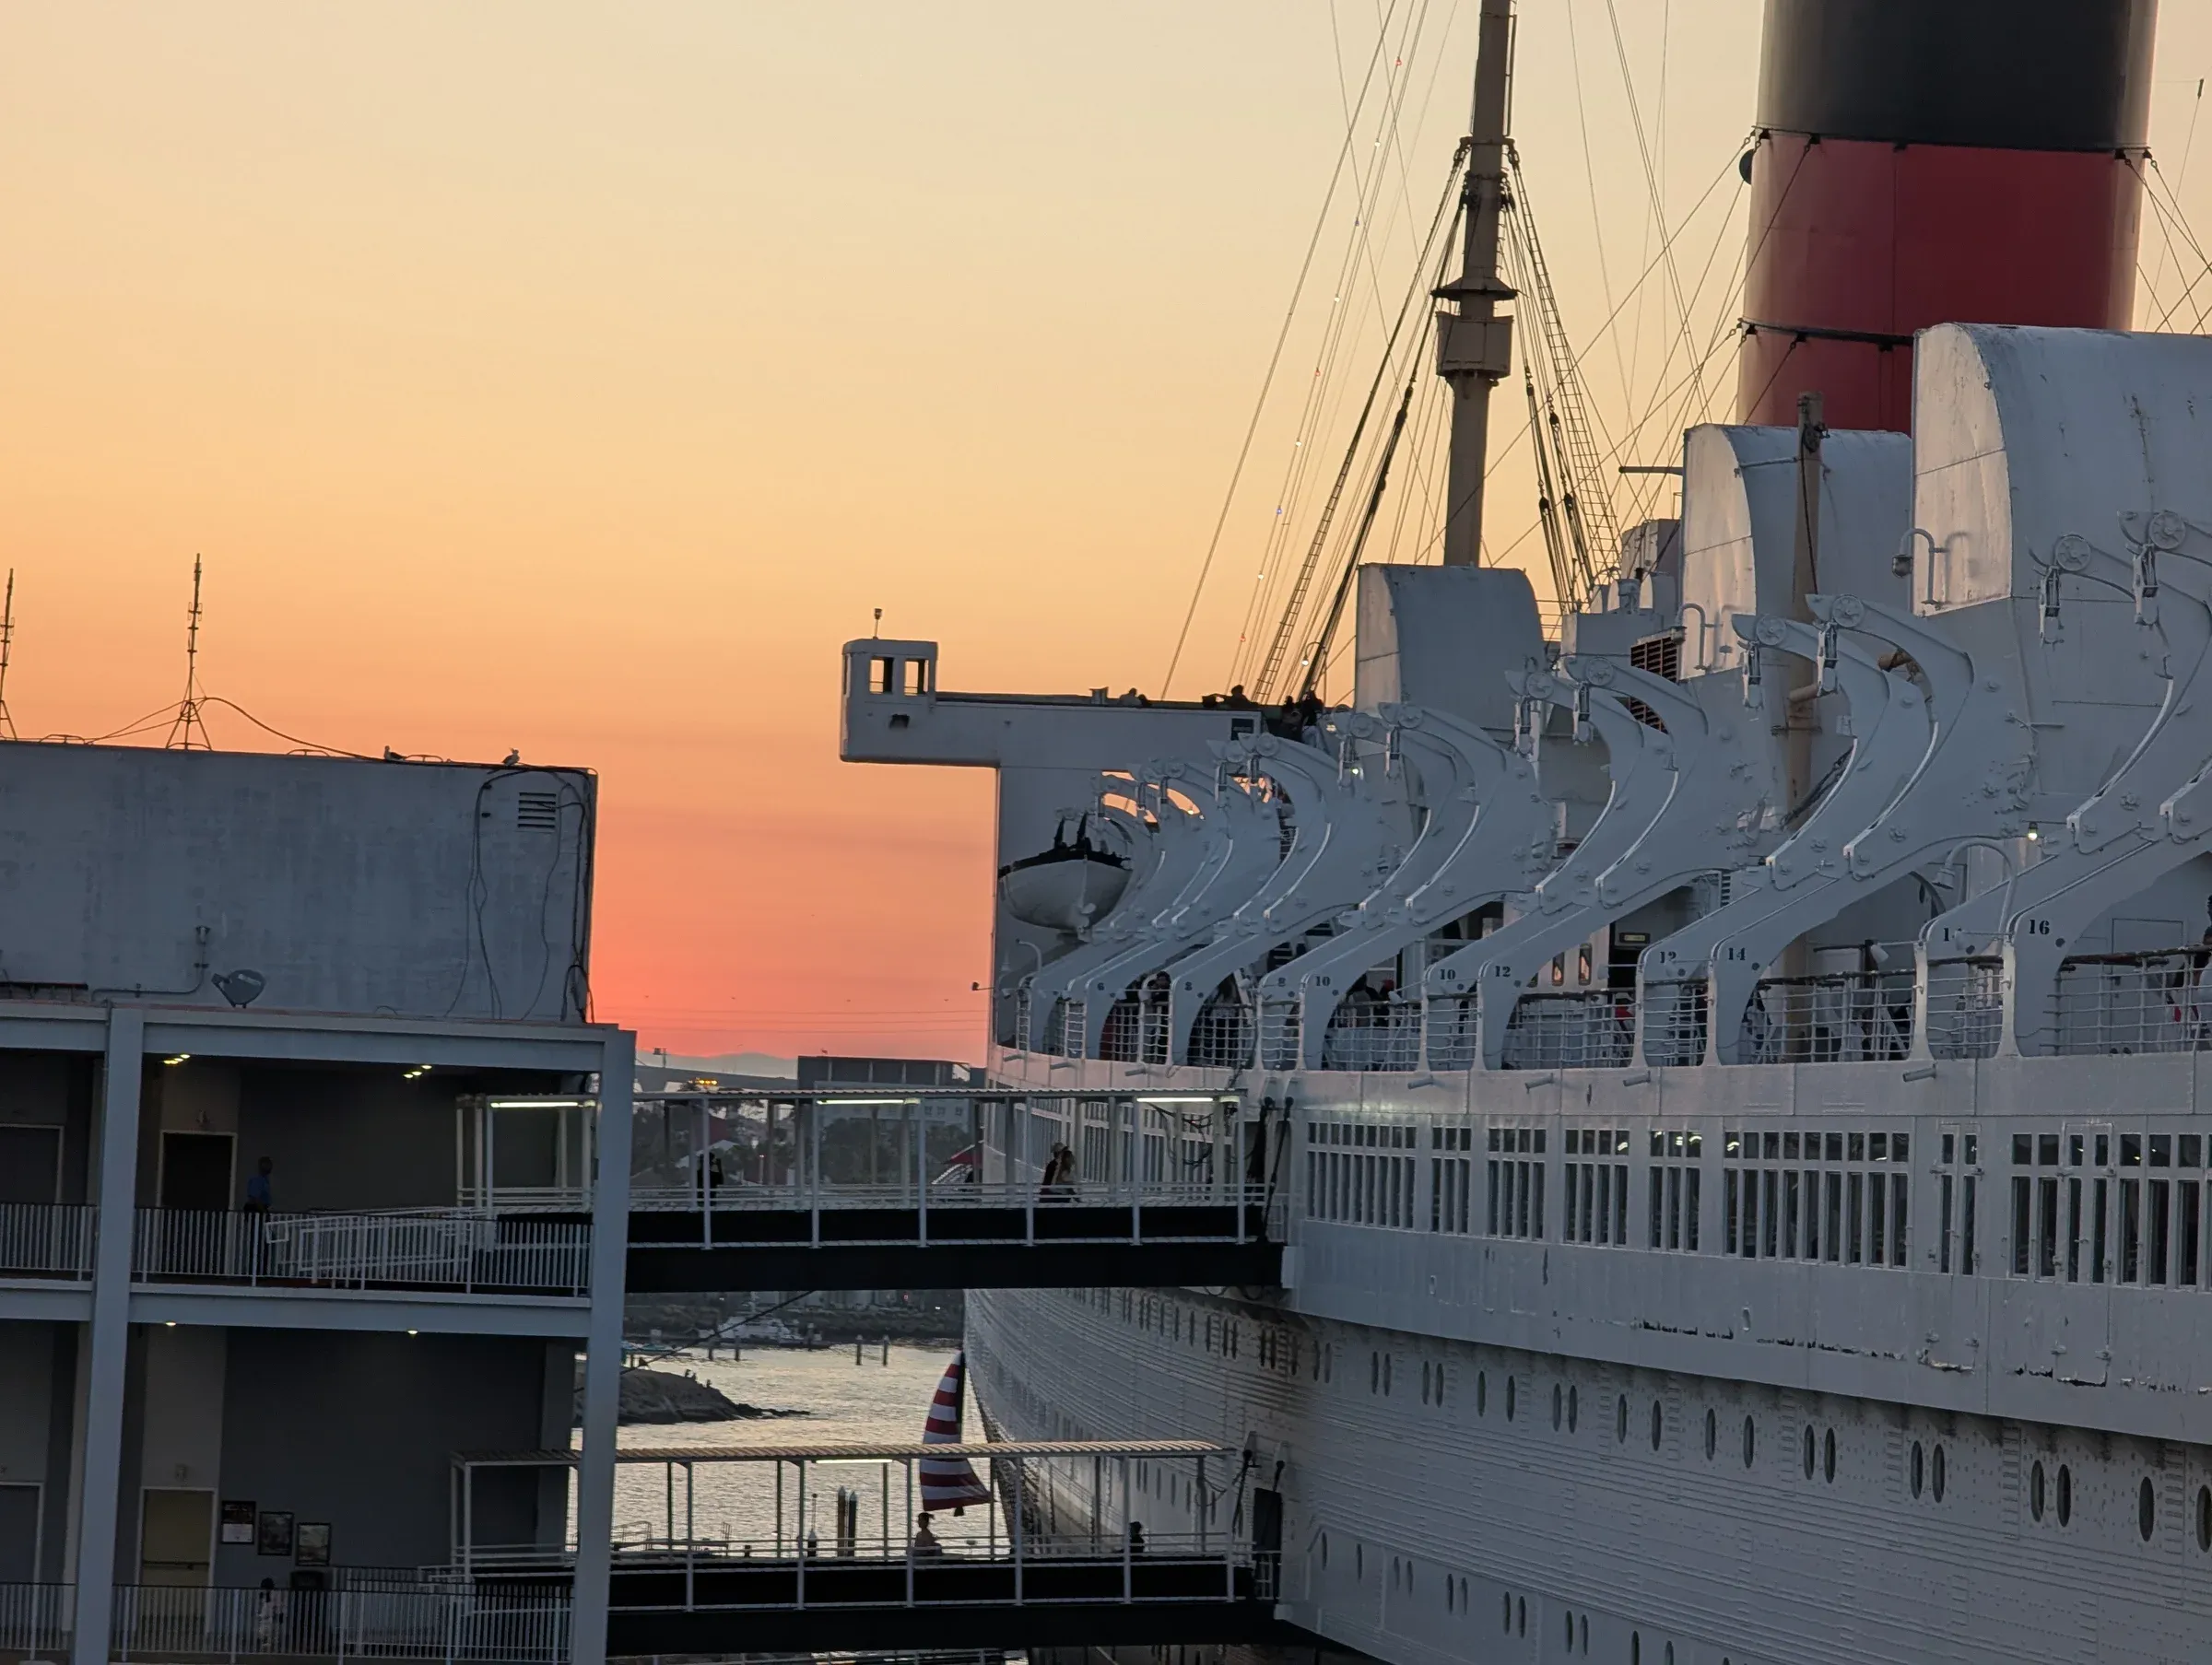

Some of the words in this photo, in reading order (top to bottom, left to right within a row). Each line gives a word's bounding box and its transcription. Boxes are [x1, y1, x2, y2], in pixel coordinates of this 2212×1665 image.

[2029, 919, 2051, 934] 16
[1728, 947, 1746, 960] 14
[1440, 968, 1456, 979] 10
[1495, 966, 1512, 977] 12
[1184, 981, 1193, 991] 8
[1316, 976, 1331, 986] 10
